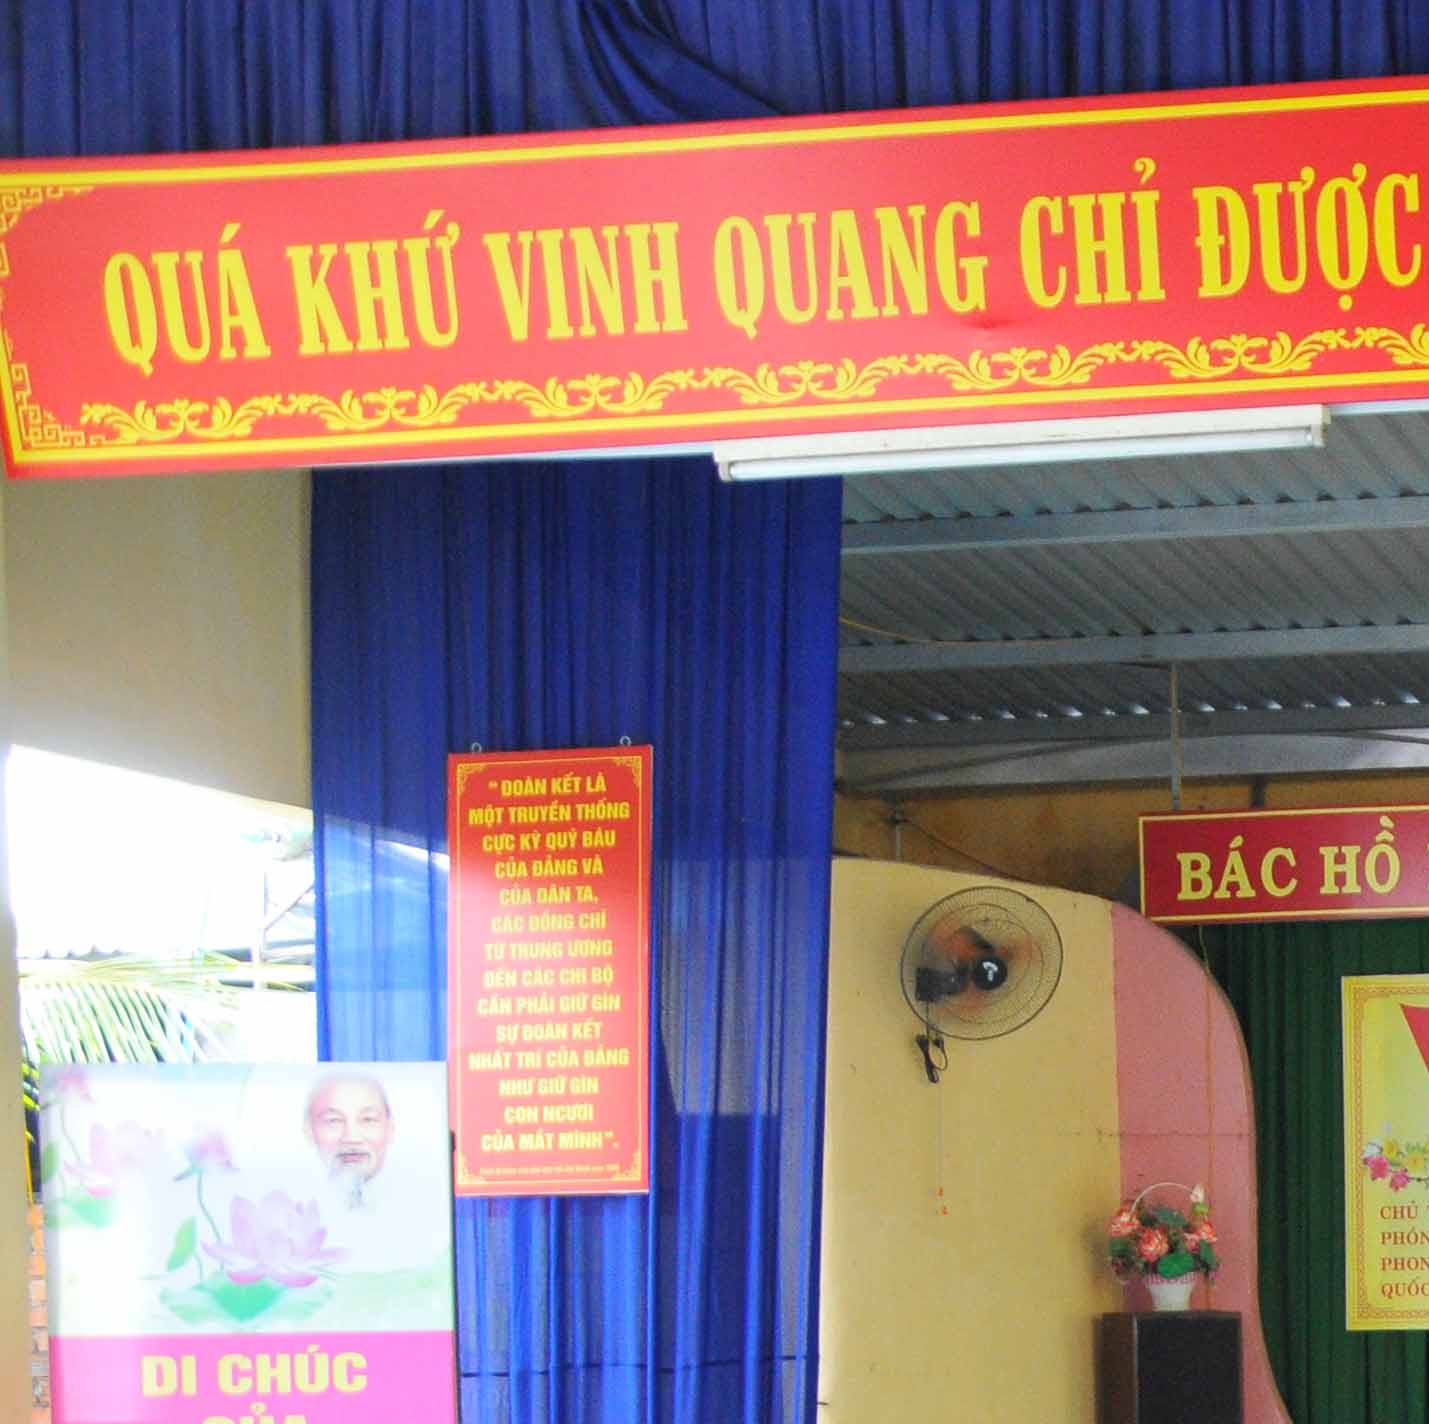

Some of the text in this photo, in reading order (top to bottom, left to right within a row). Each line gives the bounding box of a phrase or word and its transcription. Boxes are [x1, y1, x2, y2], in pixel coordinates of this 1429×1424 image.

[104, 223, 271, 376] QUÁ
[286, 210, 459, 355] KHỨ
[483, 222, 688, 341] VINH
[714, 202, 987, 339] QUANG
[1020, 158, 1165, 308] CHỈ
[1193, 163, 1421, 310] ĐƯỢC
[1175, 837, 1298, 903] BÁC
[1320, 816, 1400, 896] HỒ
[1380, 1201, 1418, 1219] CHỦ
[141, 1345, 367, 1397] DI CHÚC
